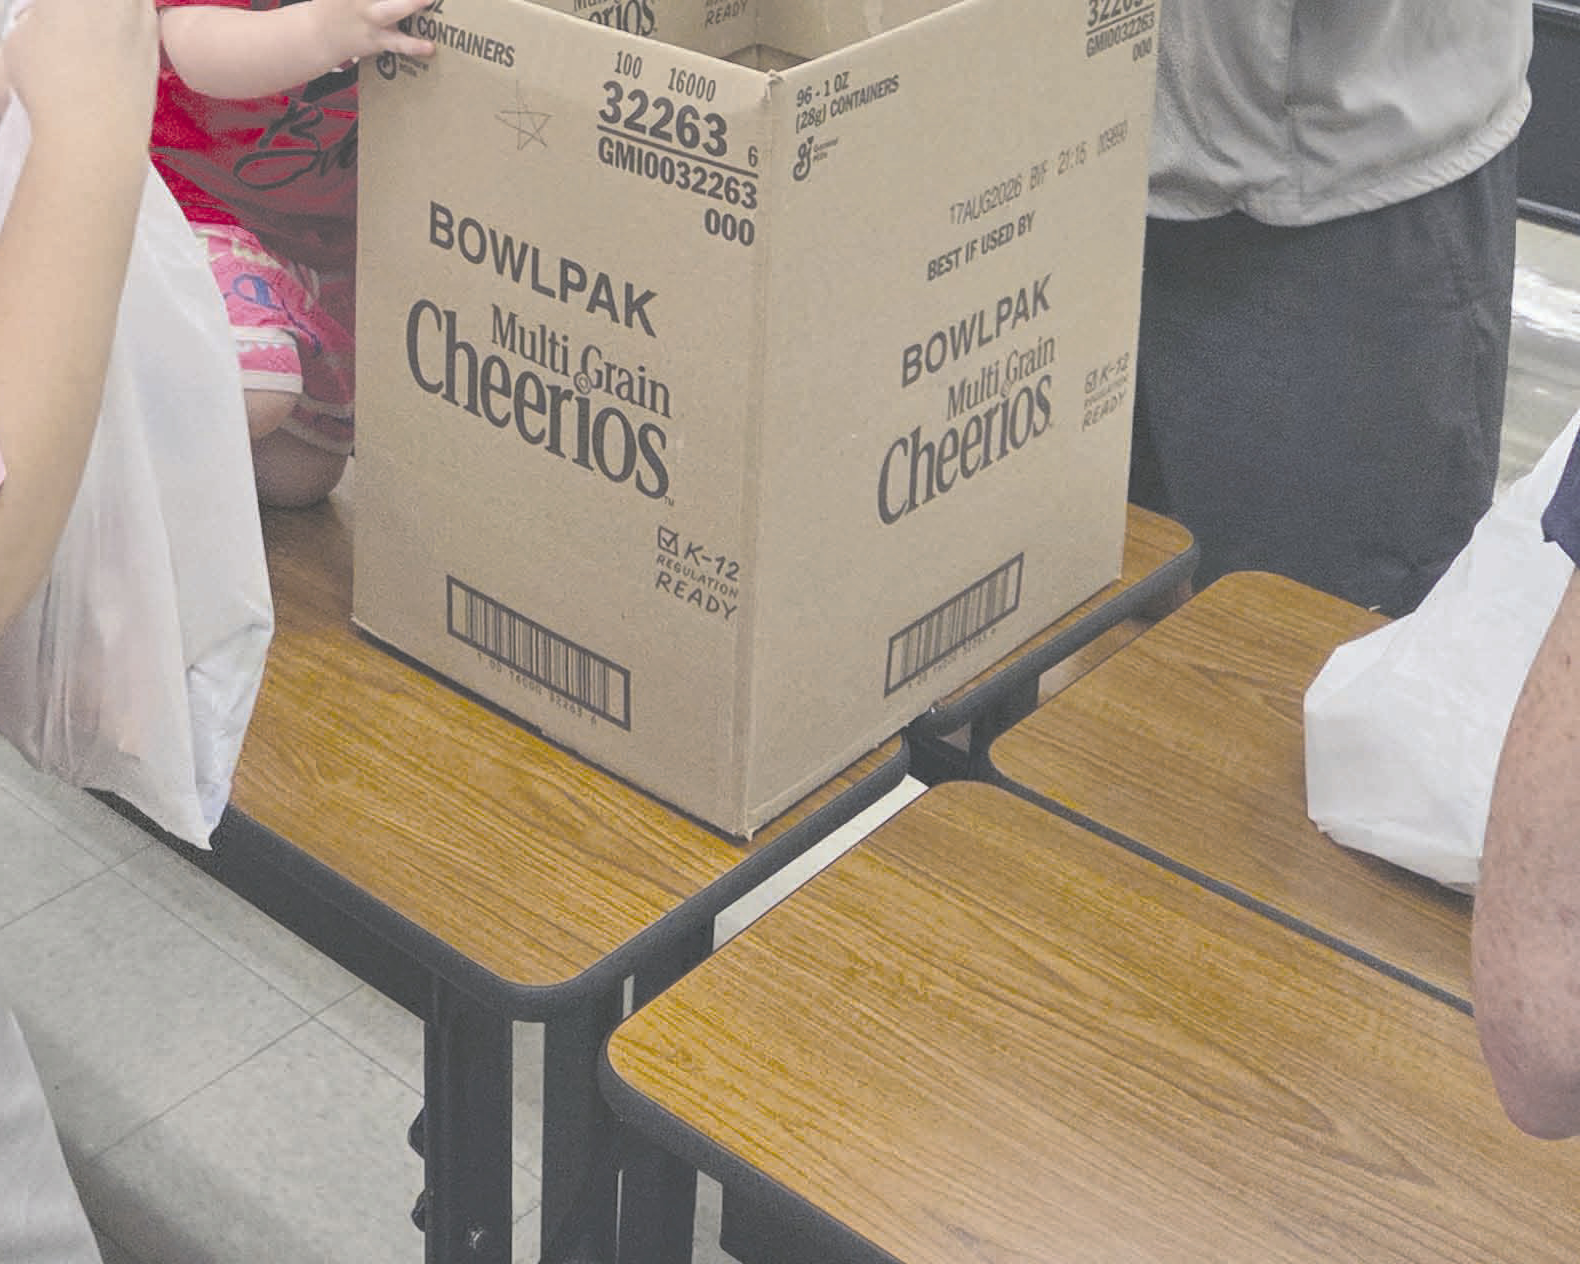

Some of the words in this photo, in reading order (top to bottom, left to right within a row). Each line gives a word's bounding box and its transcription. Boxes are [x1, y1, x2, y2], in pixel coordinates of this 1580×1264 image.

[417, 16, 515, 68] CONTAINERS
[614, 50, 642, 79] 100
[668, 67, 716, 103] 16000
[796, 86, 812, 108] 96
[824, 79, 830, 97] 1
[834, 71, 850, 93] OZ
[796, 103, 826, 134] (28g)
[830, 74, 900, 118] CONTAINERS
[598, 80, 727, 157] 32263
[748, 145, 758, 167] 6
[597, 136, 758, 210] GMI0032263
[950, 173, 1023, 225] 17AUG2026
[704, 208, 755, 246] 000
[927, 246, 962, 281] BEST
[965, 239, 978, 265] IF
[980, 222, 1015, 255] USED
[1018, 210, 1036, 237] BY
[430, 200, 658, 338] BOWLPAK
[491, 303, 569, 377] Multi
[576, 344, 672, 419] Grain
[901, 273, 1052, 388] BOWLPAK
[406, 299, 669, 499] Cheerios
[947, 360, 1000, 421] Multi
[1004, 336, 1055, 388] Grain
[878, 374, 1053, 525] Cheerios
[657, 554, 739, 599] REGULATION
[684, 541, 740, 582] K-12
[655, 571, 738, 620] READY
